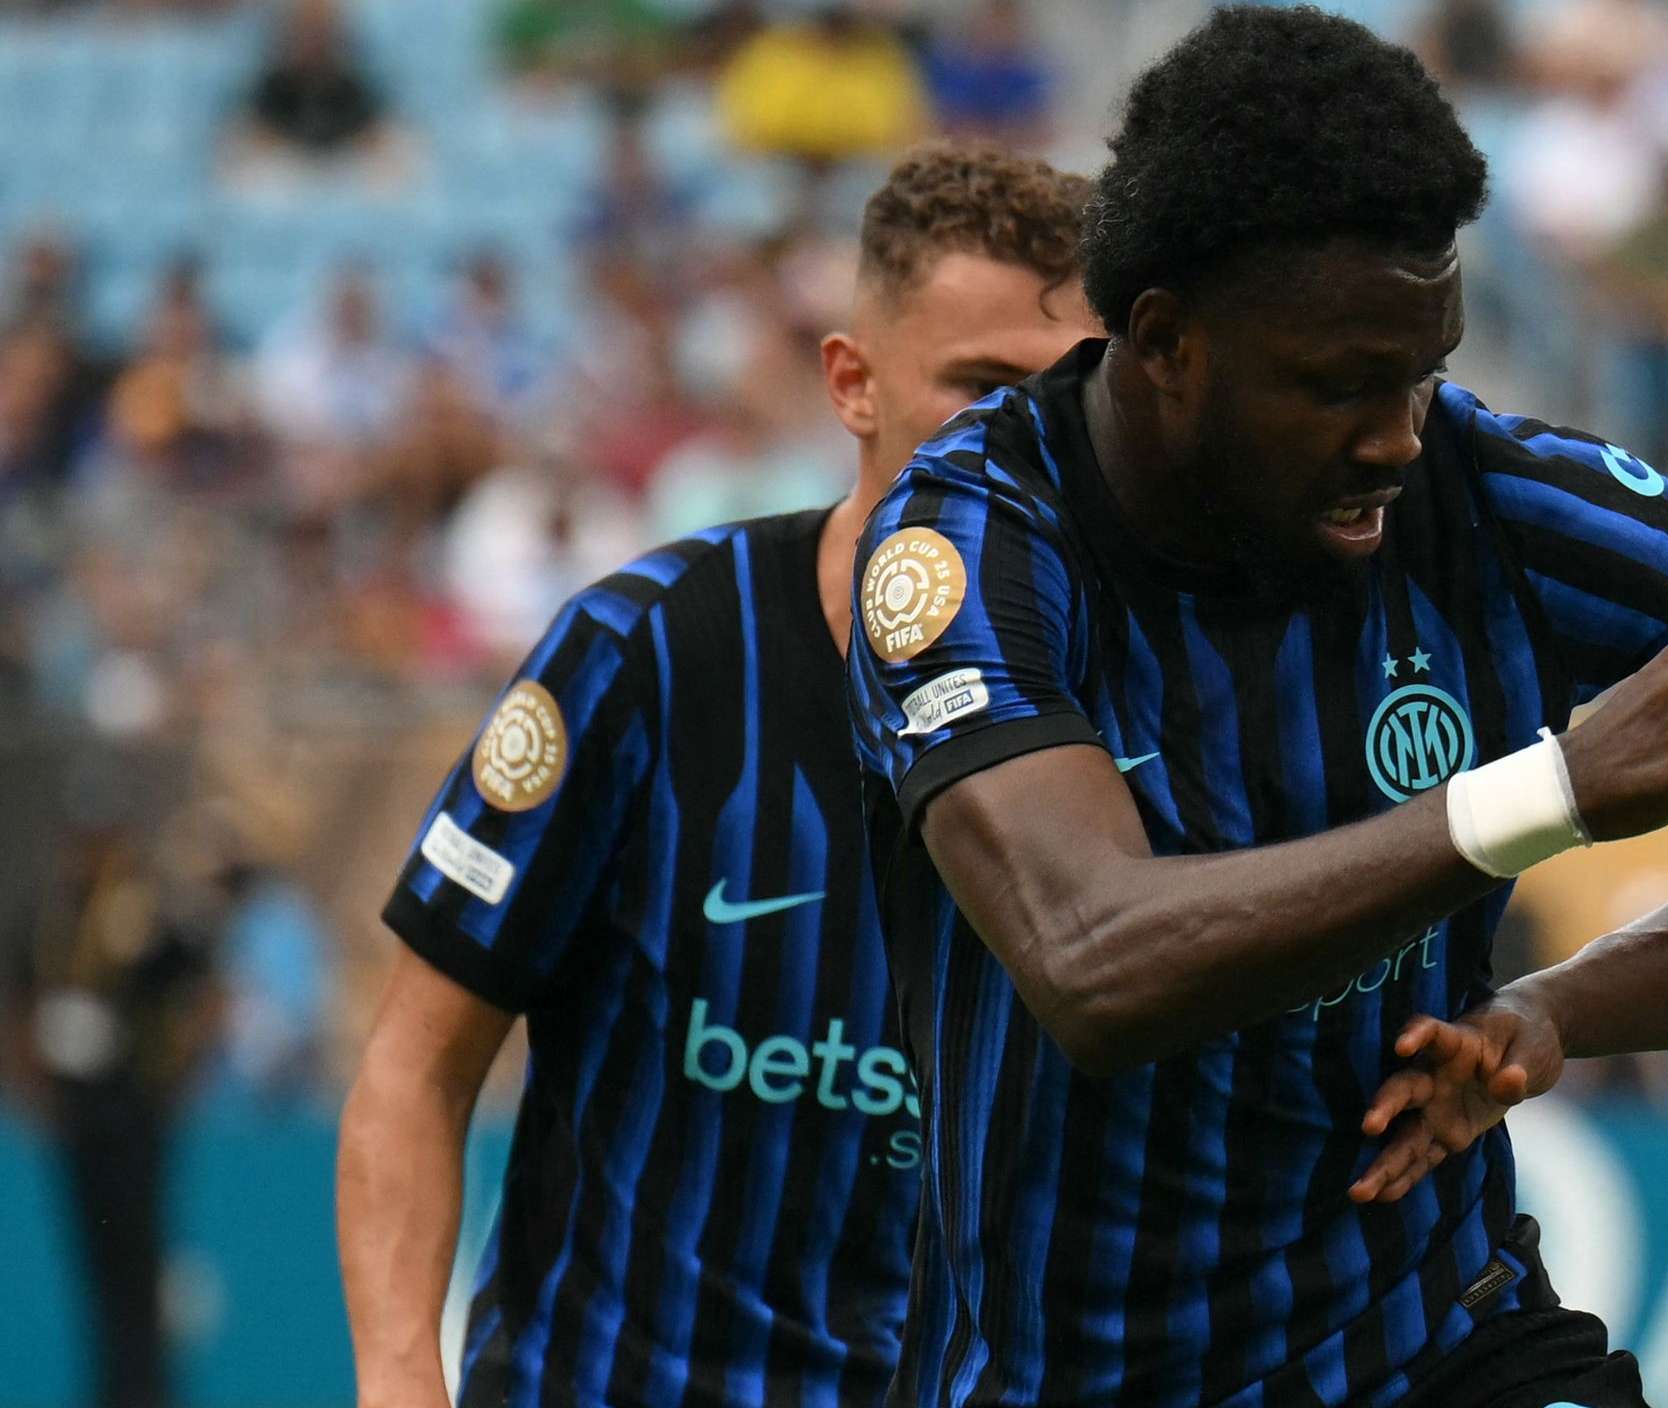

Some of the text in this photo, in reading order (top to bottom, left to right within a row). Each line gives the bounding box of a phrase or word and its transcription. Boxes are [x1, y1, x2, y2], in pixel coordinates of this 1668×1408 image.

[909, 540, 940, 559] CUP
[866, 543, 905, 592] WORLD
[934, 560, 951, 580] 25
[927, 585, 950, 617] USA
[886, 624, 924, 653] FIFA
[947, 692, 971, 711] FIFA
[683, 997, 921, 1120] bets
